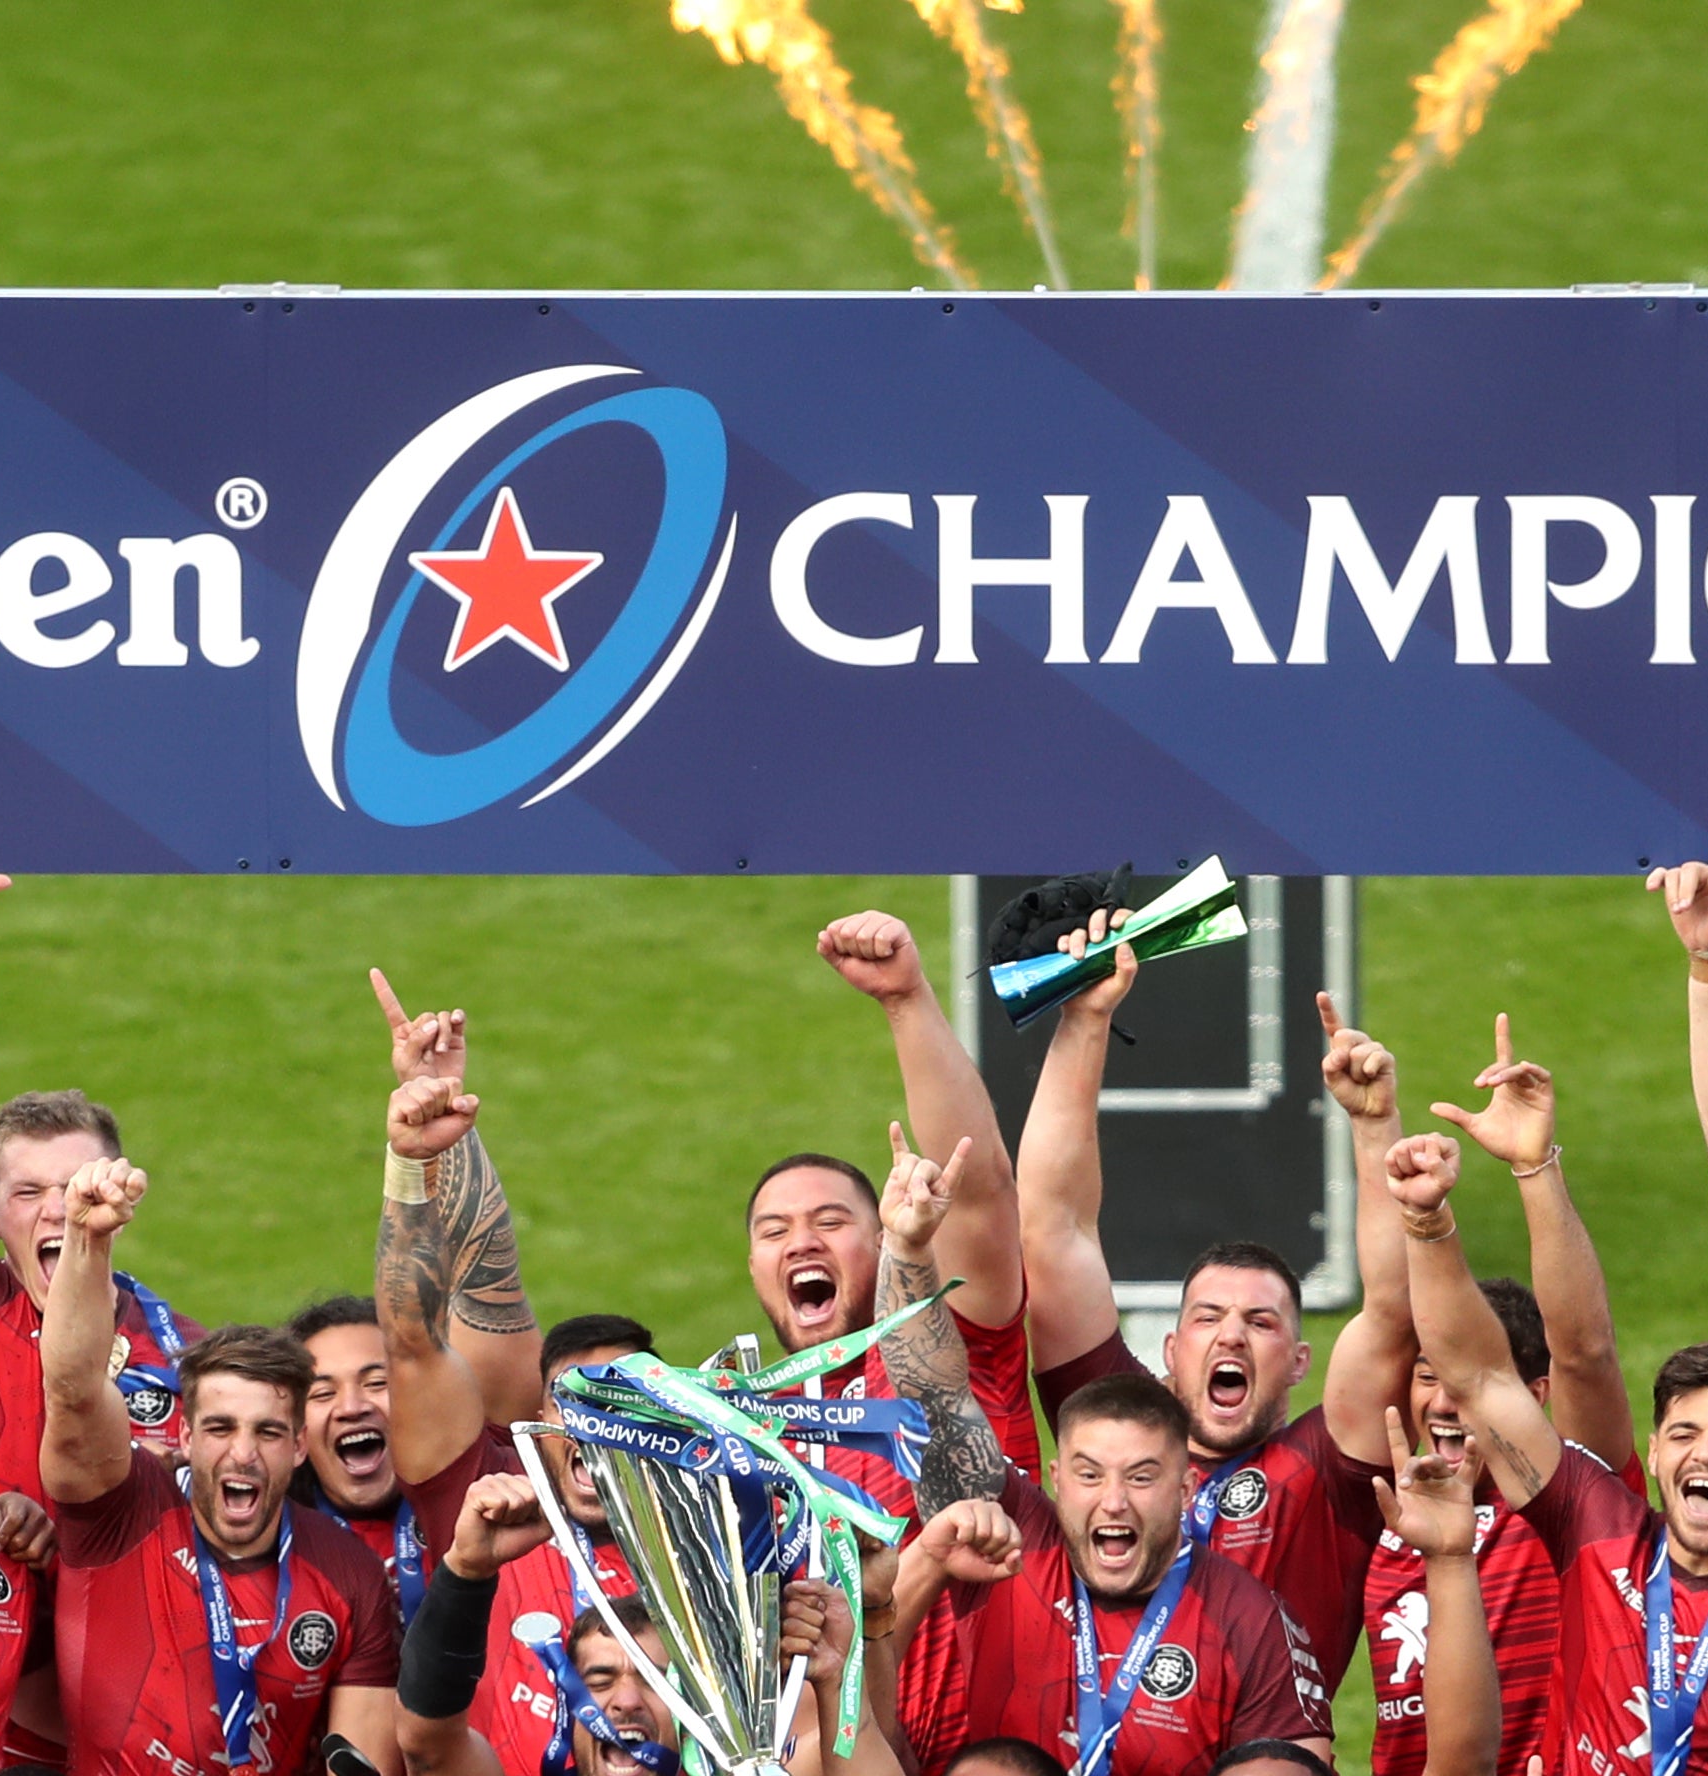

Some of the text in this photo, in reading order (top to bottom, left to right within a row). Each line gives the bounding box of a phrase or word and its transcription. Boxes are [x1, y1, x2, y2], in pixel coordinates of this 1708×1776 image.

[746, 1354, 824, 1391] Heineken
[563, 1407, 682, 1455] CHAMPIONS
[824, 1405, 866, 1425] CUP
[724, 1436, 752, 1476] CUP
